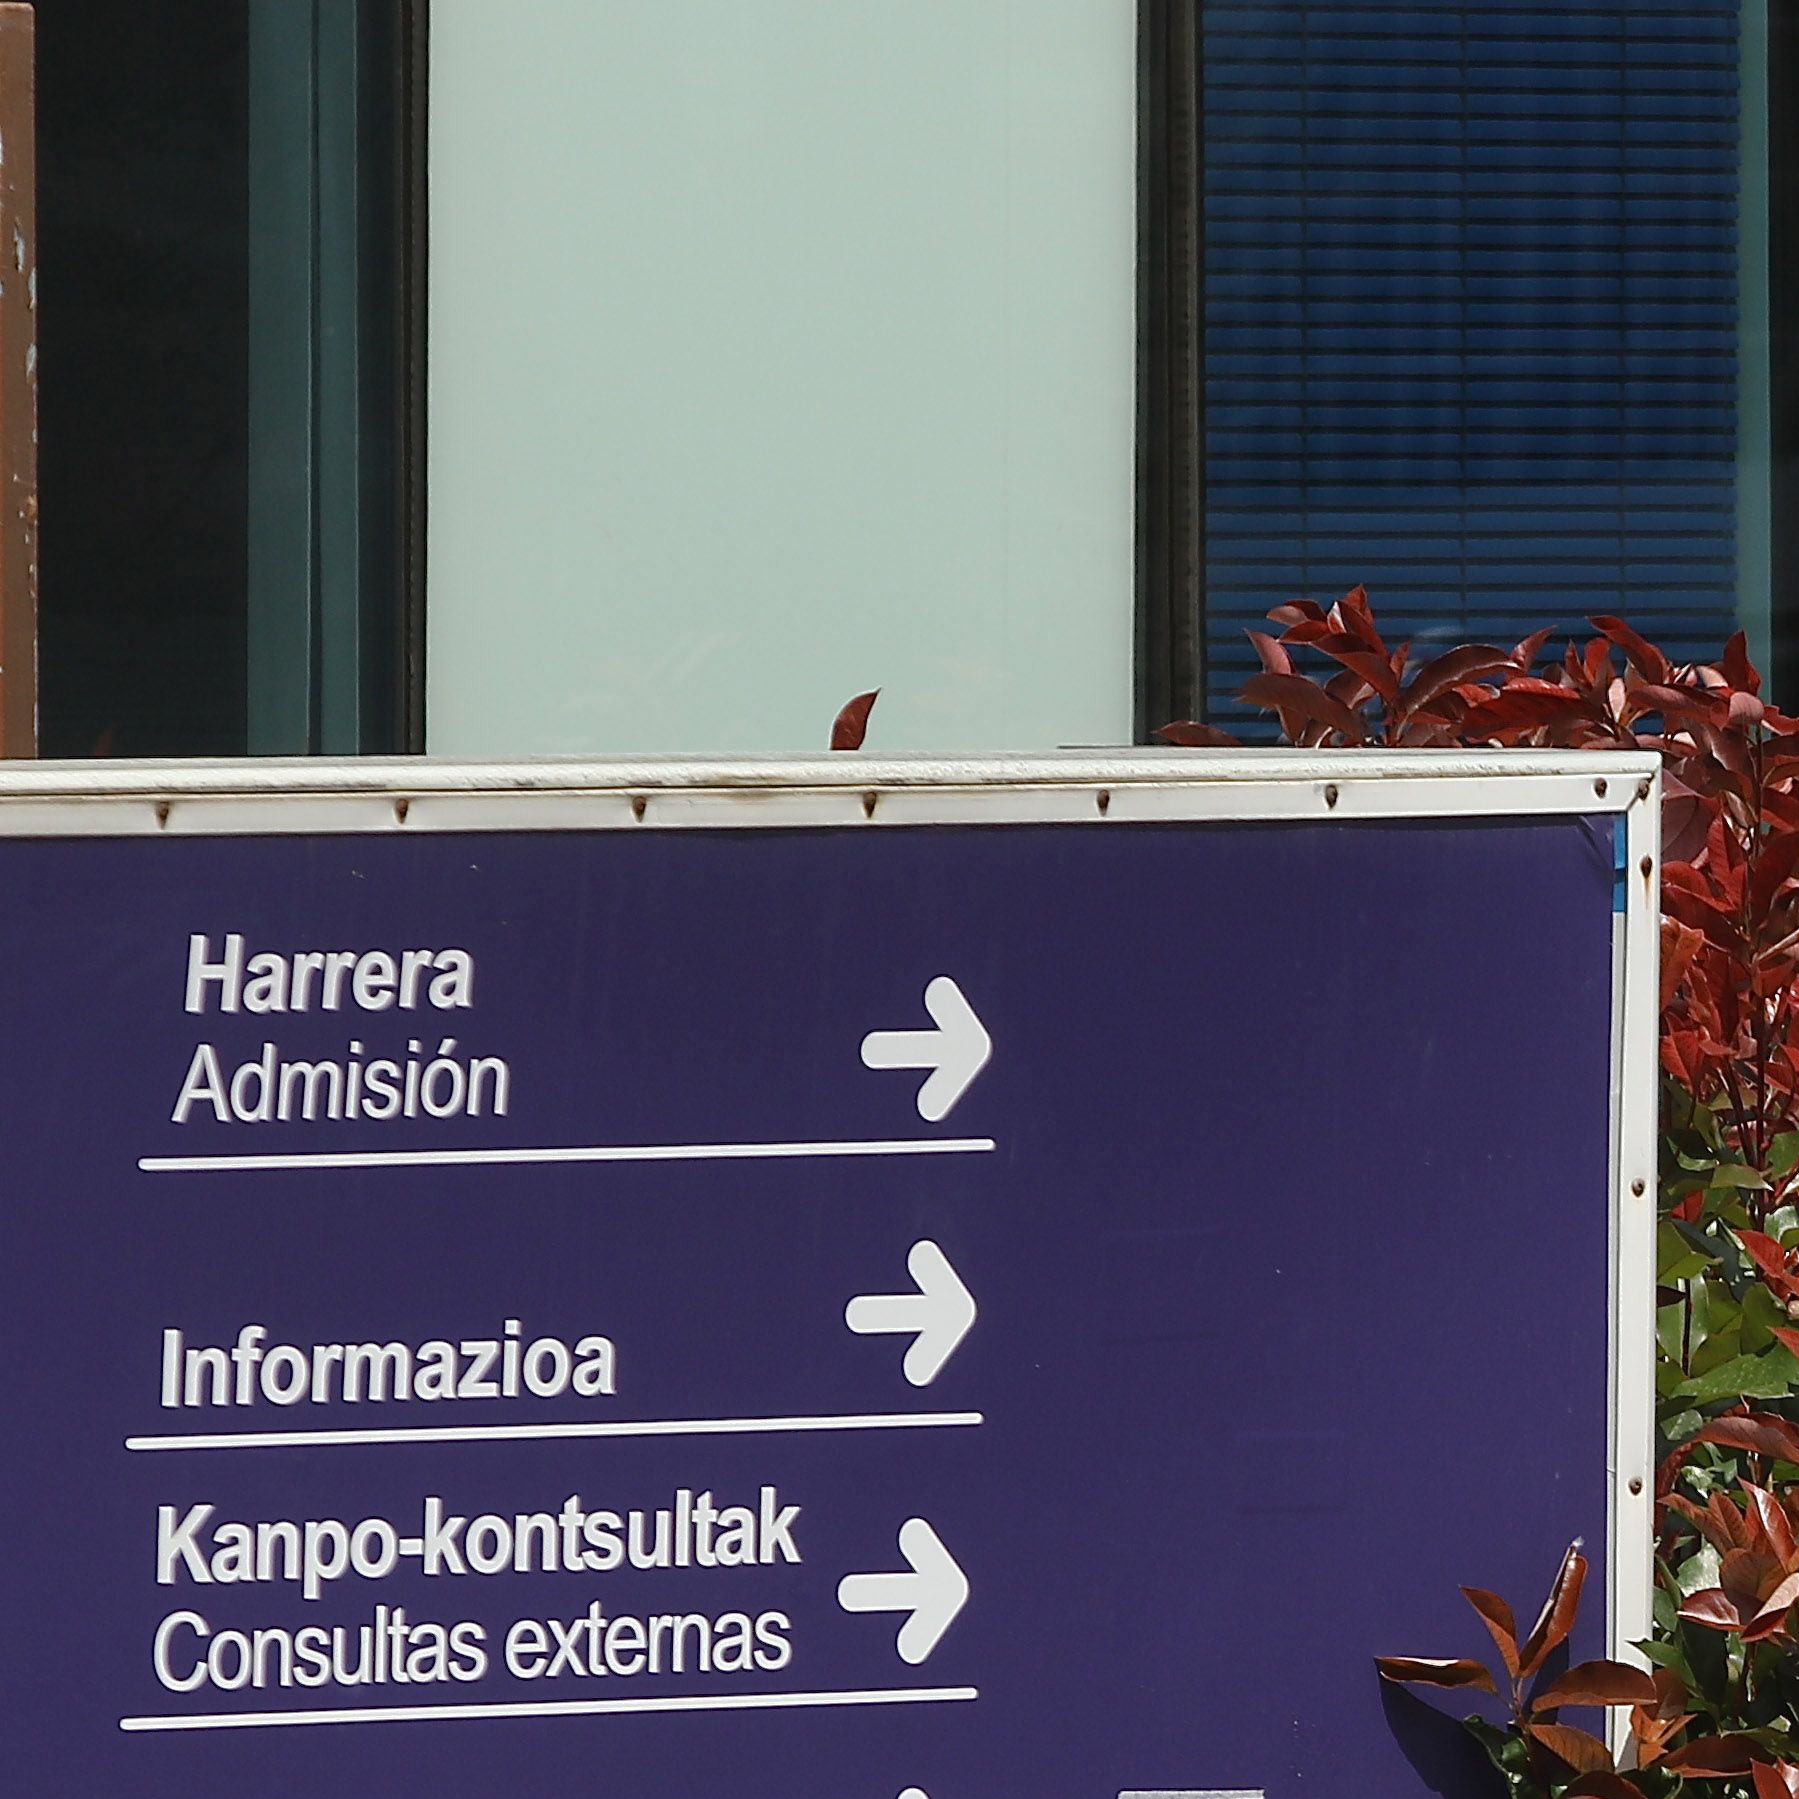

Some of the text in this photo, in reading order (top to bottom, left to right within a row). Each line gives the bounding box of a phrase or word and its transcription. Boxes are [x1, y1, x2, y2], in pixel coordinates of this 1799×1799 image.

[183, 934, 474, 1016] Harrera
[173, 1039, 509, 1125] Admisión
[159, 1319, 616, 1408] Informazioa
[155, 1486, 801, 1598] Kanpo-kontsultak
[153, 1606, 793, 1692] Consultas externas
